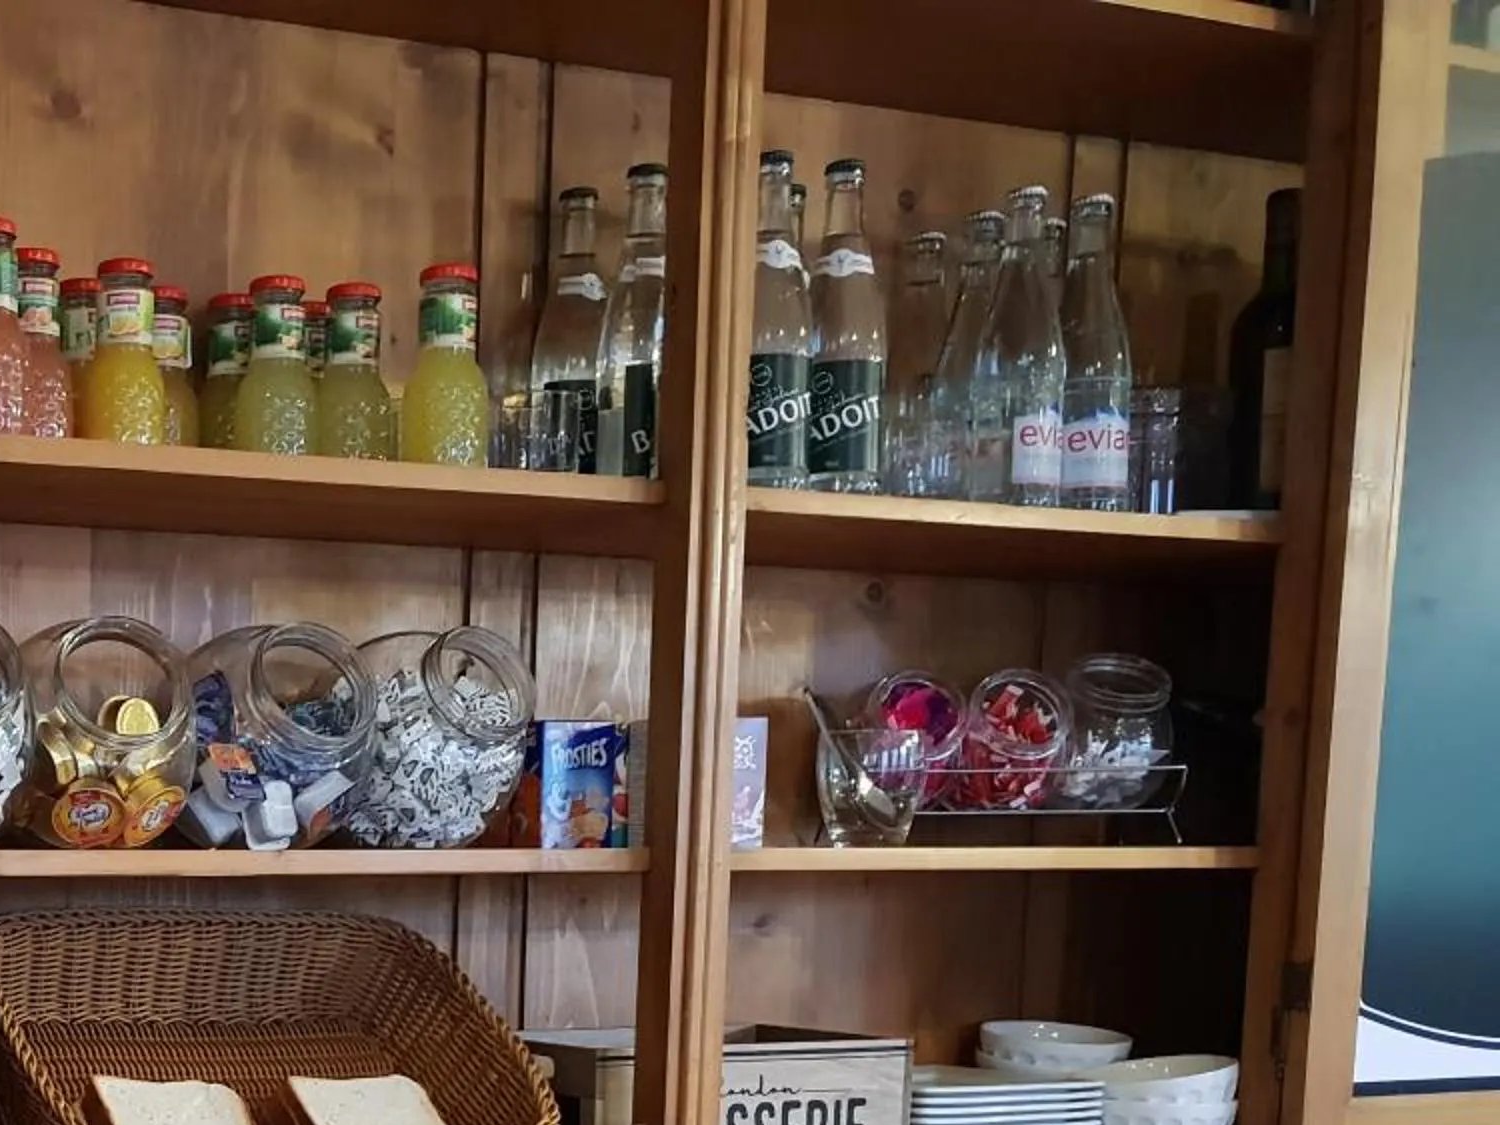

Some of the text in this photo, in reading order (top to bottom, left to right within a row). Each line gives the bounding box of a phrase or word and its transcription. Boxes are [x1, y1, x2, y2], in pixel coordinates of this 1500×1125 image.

[1067, 423, 1132, 453] evia
[551, 737, 608, 775] FROSTIES
[719, 1073, 801, 1097] ondon
